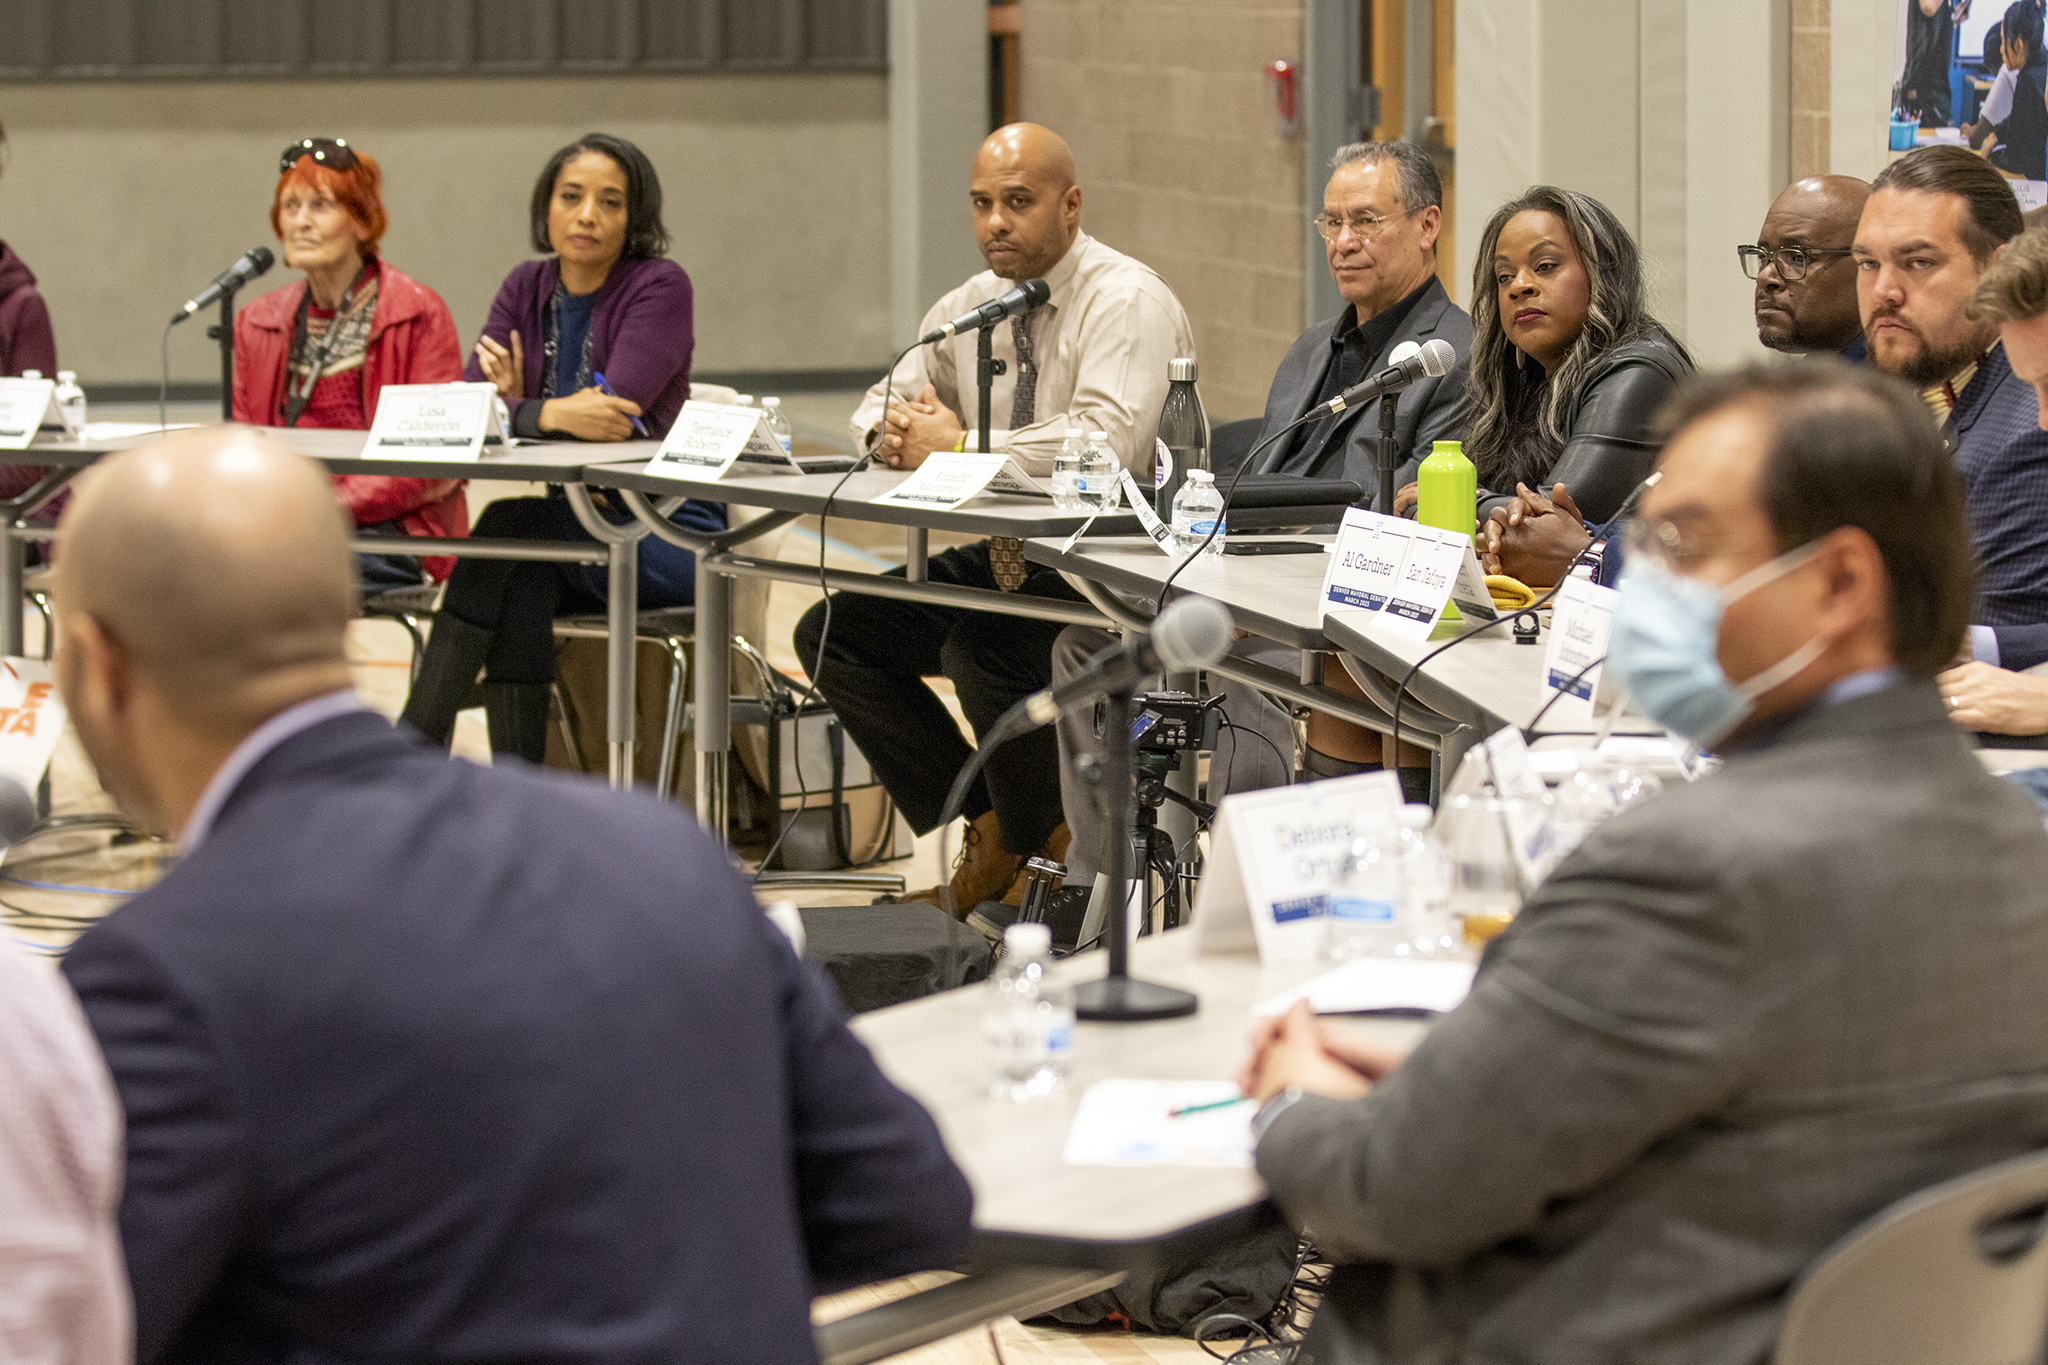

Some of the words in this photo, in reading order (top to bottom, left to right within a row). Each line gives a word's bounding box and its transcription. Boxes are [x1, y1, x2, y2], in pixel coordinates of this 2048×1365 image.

[418, 404, 446, 417] Lisa
[690, 422, 734, 438] Terrance
[683, 436, 723, 451] Roberts
[932, 471, 971, 482] Aurelio
[1342, 551, 1355, 567] Al
[1354, 552, 1395, 576] Gardner
[1333, 585, 1350, 595] DENVER
[1349, 588, 1370, 600] MAYORAL
[1369, 593, 1387, 603] DEBATE
[1344, 595, 1359, 605] MARCH
